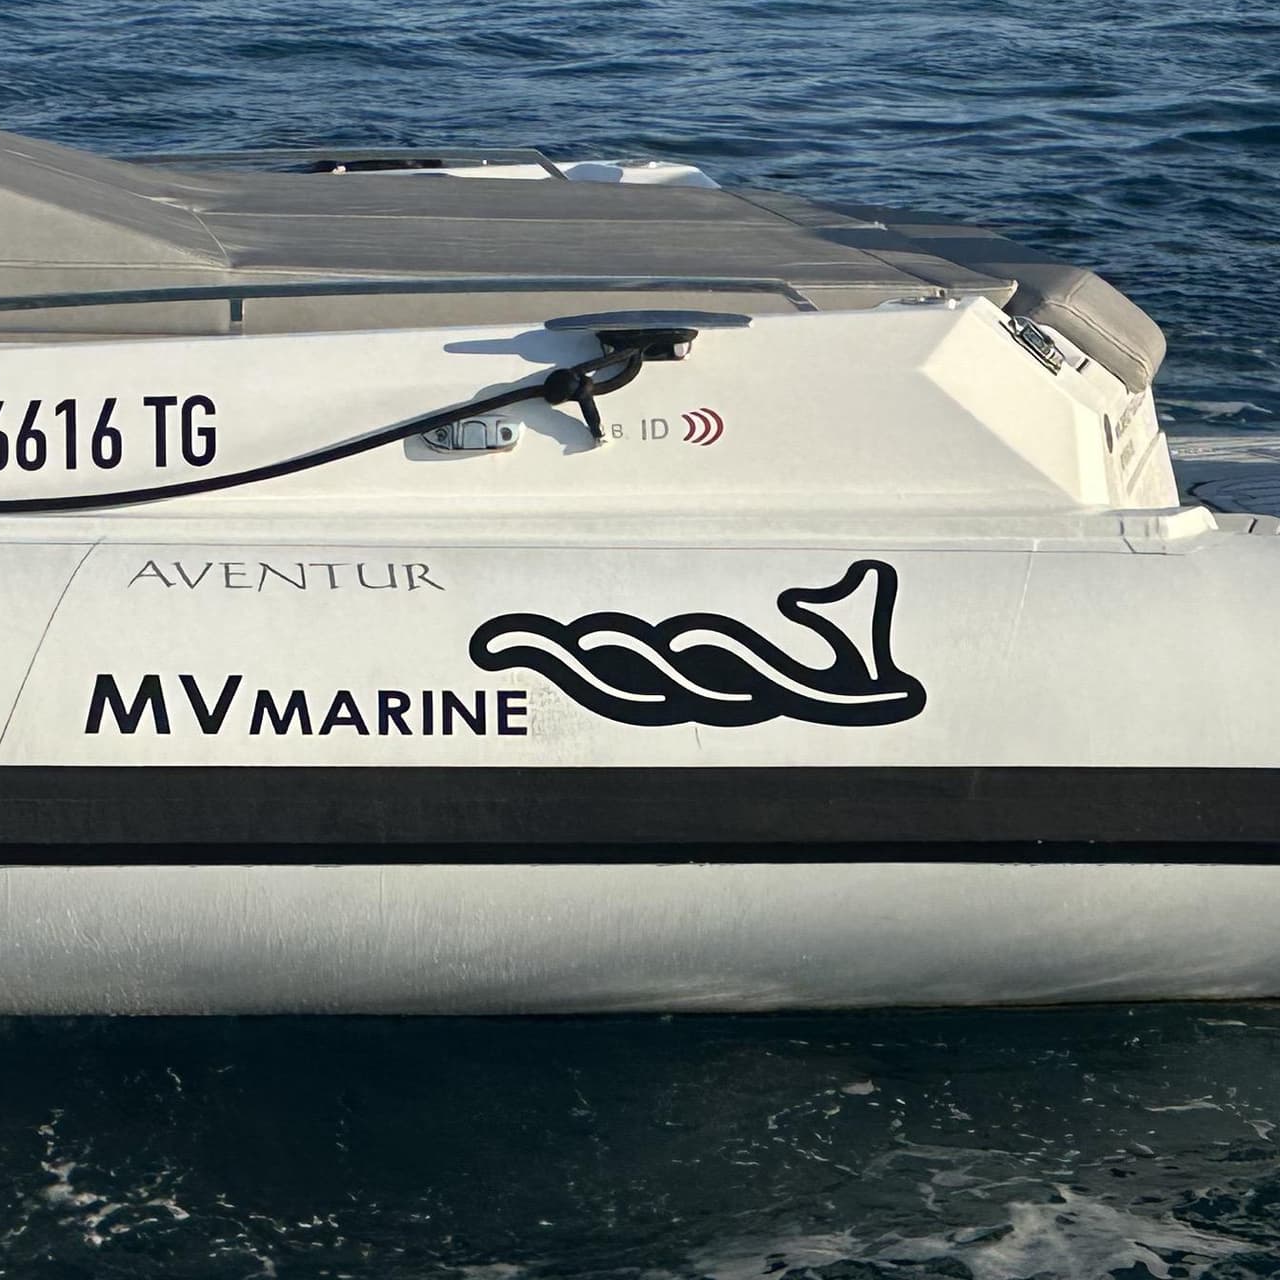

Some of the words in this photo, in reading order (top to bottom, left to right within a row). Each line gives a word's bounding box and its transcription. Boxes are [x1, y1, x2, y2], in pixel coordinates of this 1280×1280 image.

[143, 395, 217, 468] TG
[641, 418, 669, 441] ID
[127, 559, 445, 592] AVENTUR
